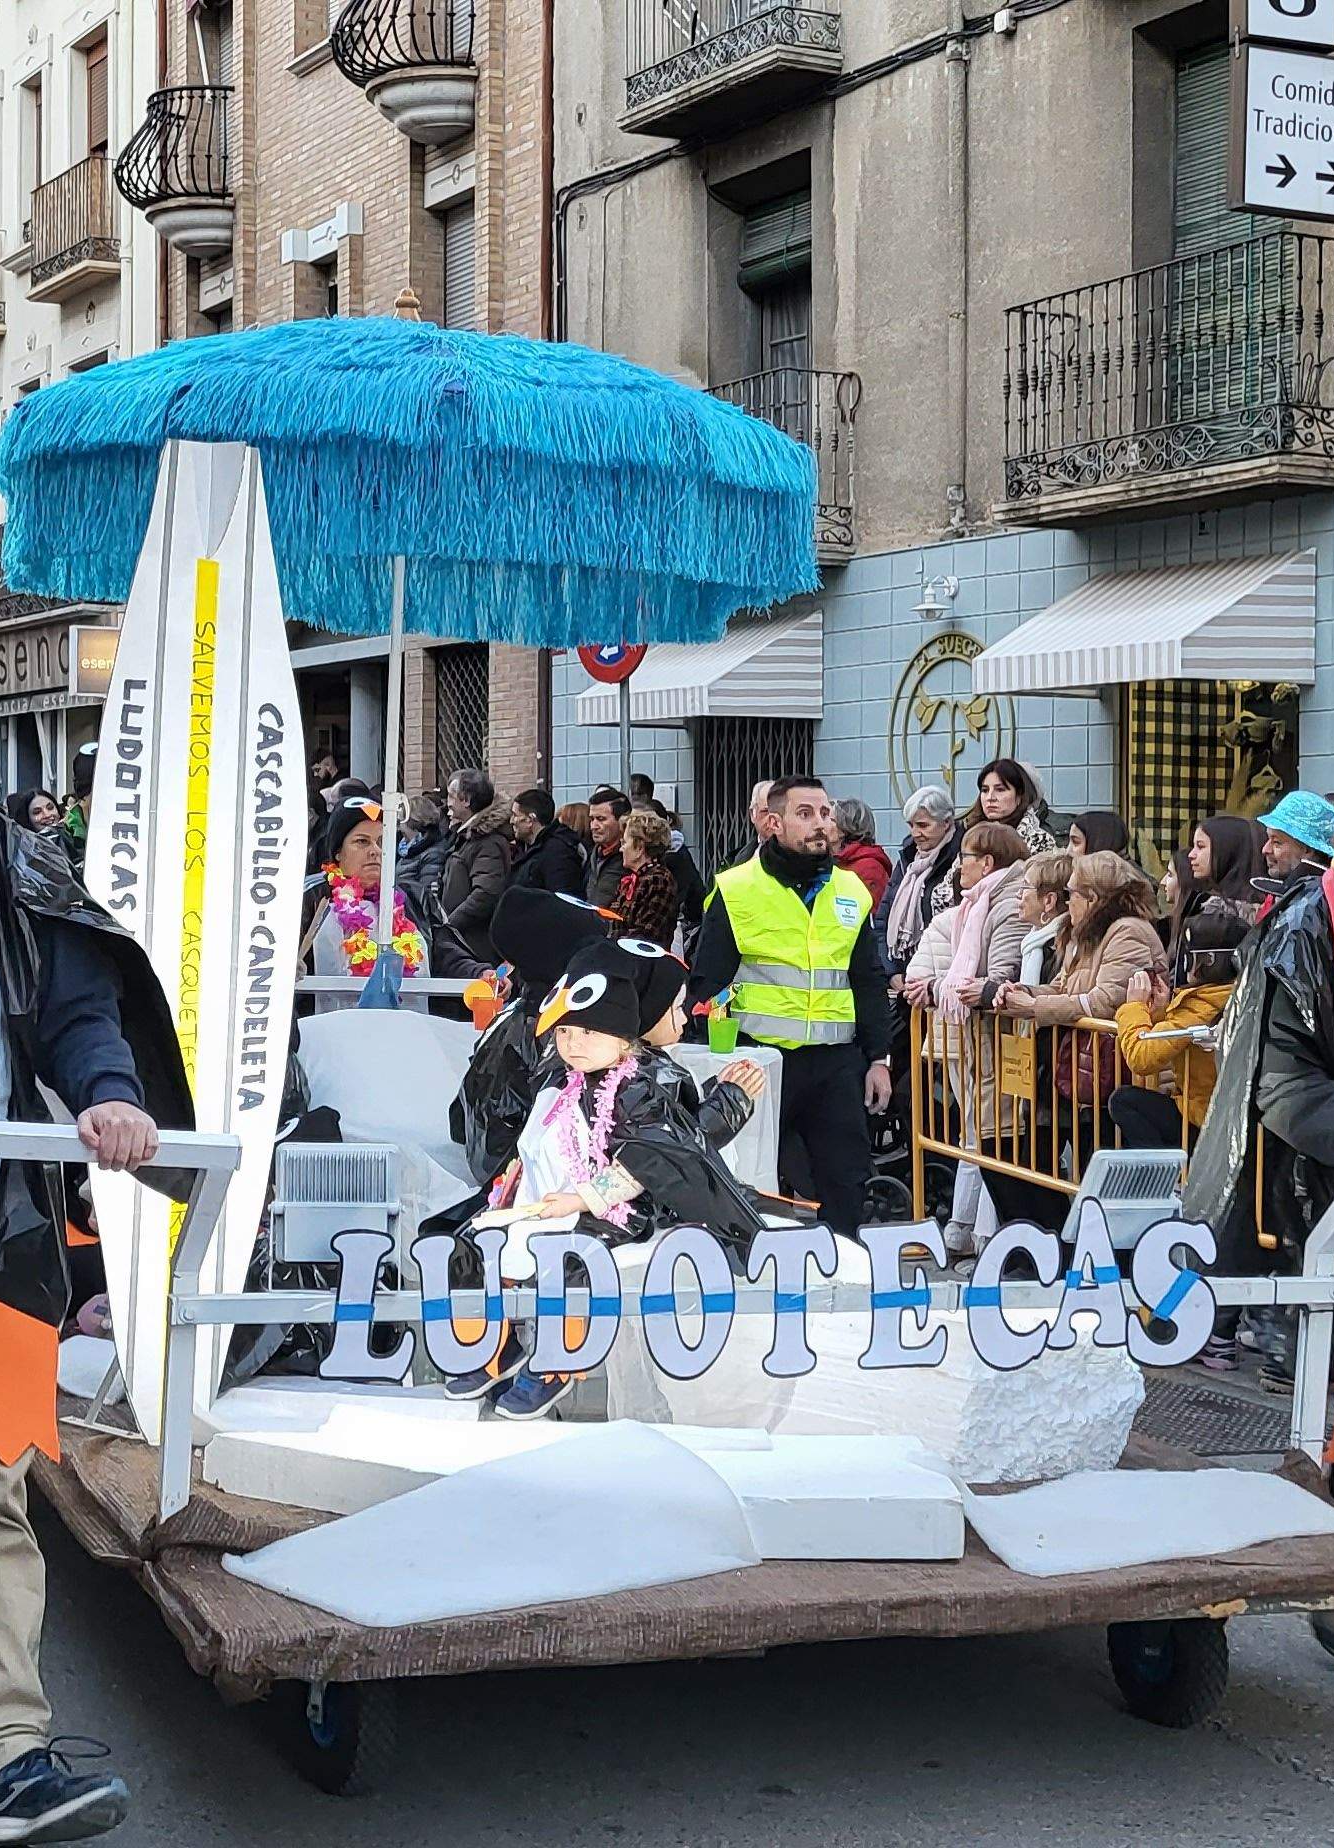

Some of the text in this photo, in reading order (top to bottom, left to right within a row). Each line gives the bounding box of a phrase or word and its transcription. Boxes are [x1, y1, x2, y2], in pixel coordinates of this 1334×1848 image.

[188, 621, 216, 778] SALVEMOS
[108, 679, 147, 913] LUDOTECAS
[183, 811, 208, 872] LOS
[319, 1198, 1217, 1380] LUDOTECAS
